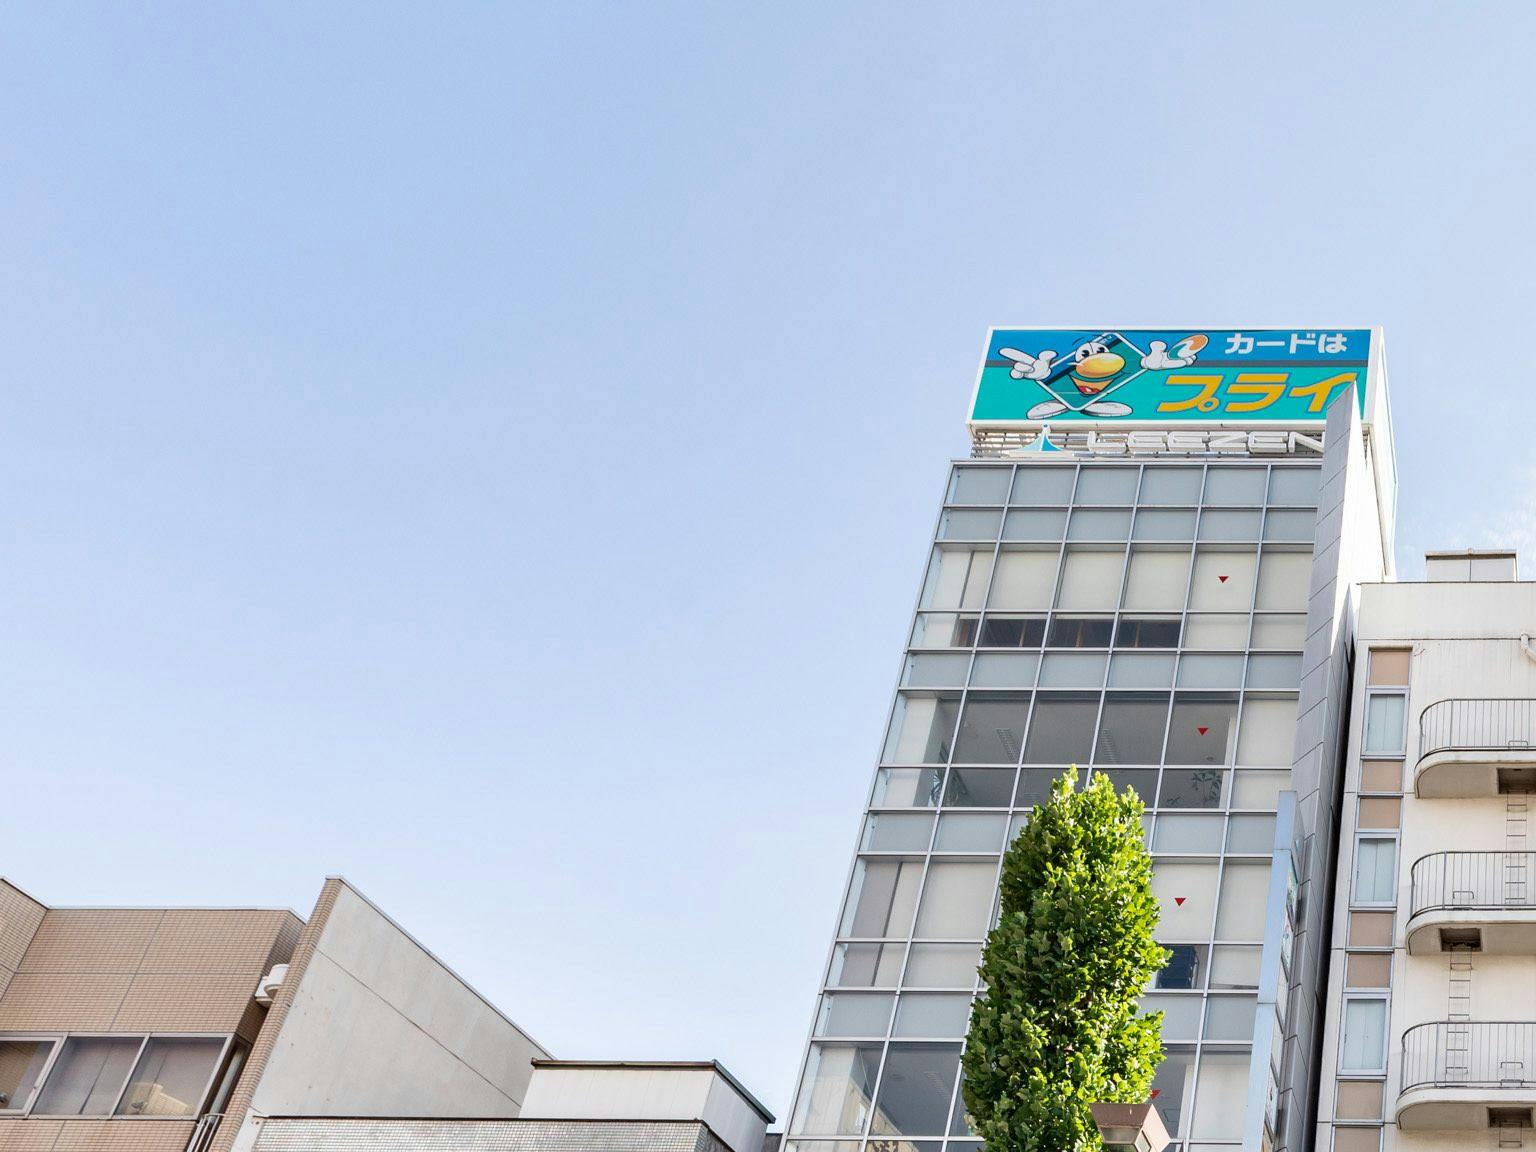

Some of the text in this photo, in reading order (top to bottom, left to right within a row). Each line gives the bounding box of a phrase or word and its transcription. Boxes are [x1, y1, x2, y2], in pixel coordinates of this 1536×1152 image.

[1225, 332, 1348, 354] カードは
[1157, 373, 1357, 413] プライ
